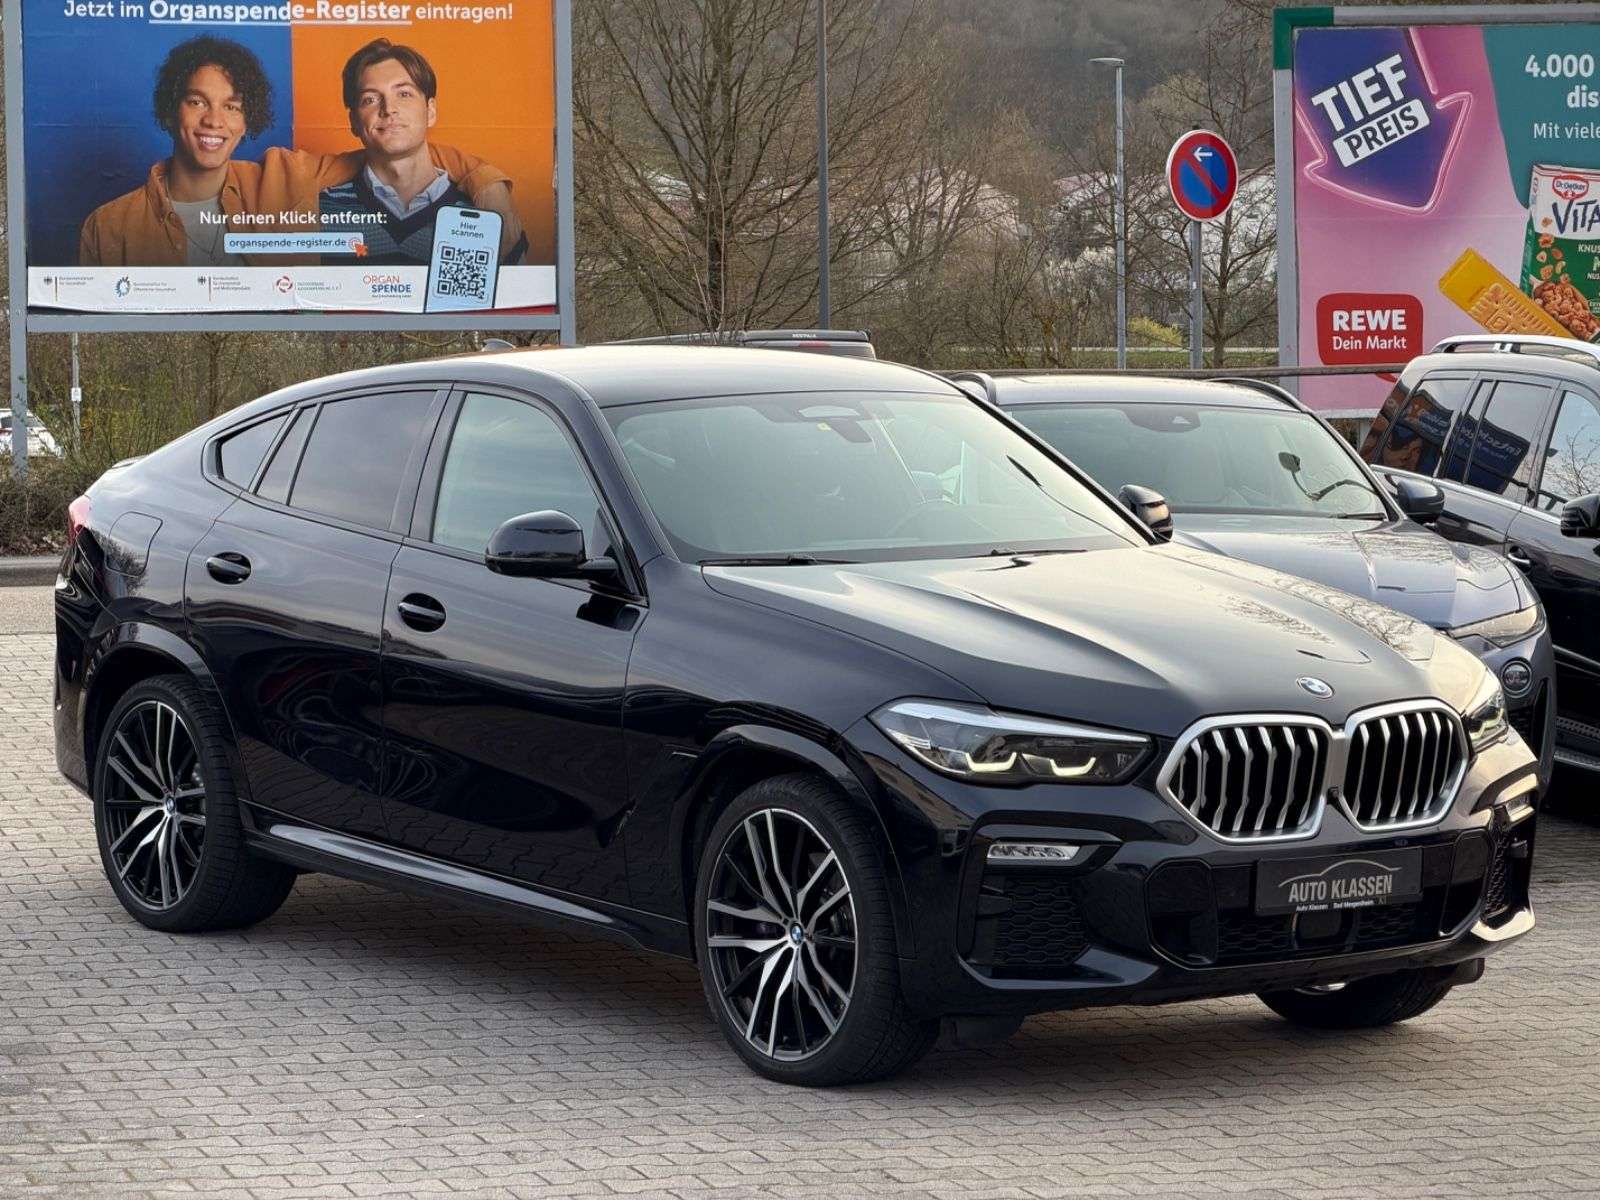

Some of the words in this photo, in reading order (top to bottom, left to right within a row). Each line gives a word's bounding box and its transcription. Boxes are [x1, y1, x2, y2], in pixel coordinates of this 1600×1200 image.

[64, 0, 115, 17] Jetzt
[120, 0, 144, 17] im
[149, 0, 411, 22] Organspende-Register
[415, 3, 513, 23] eintragen!
[1525, 54, 1594, 77] 4.000
[1311, 54, 1407, 131] TIEF
[1343, 105, 1419, 159] PREIS
[1533, 122, 1560, 138] Mit
[200, 211, 228, 224] Nur
[232, 211, 275, 224] einen
[279, 211, 317, 224] Klick
[320, 210, 387, 225] entfernt:
[460, 221, 477, 230] Hier
[450, 229, 484, 239] scannen
[229, 235, 347, 249] organspende-register.de
[362, 274, 400, 285] ORGAN
[371, 283, 412, 293] SPENDE
[1332, 309, 1407, 331] REWE
[1332, 335, 1362, 350] Dein
[1366, 335, 1407, 350] Markt
[1288, 881, 1328, 902] AUTO
[1331, 874, 1393, 899] KLASSEN
